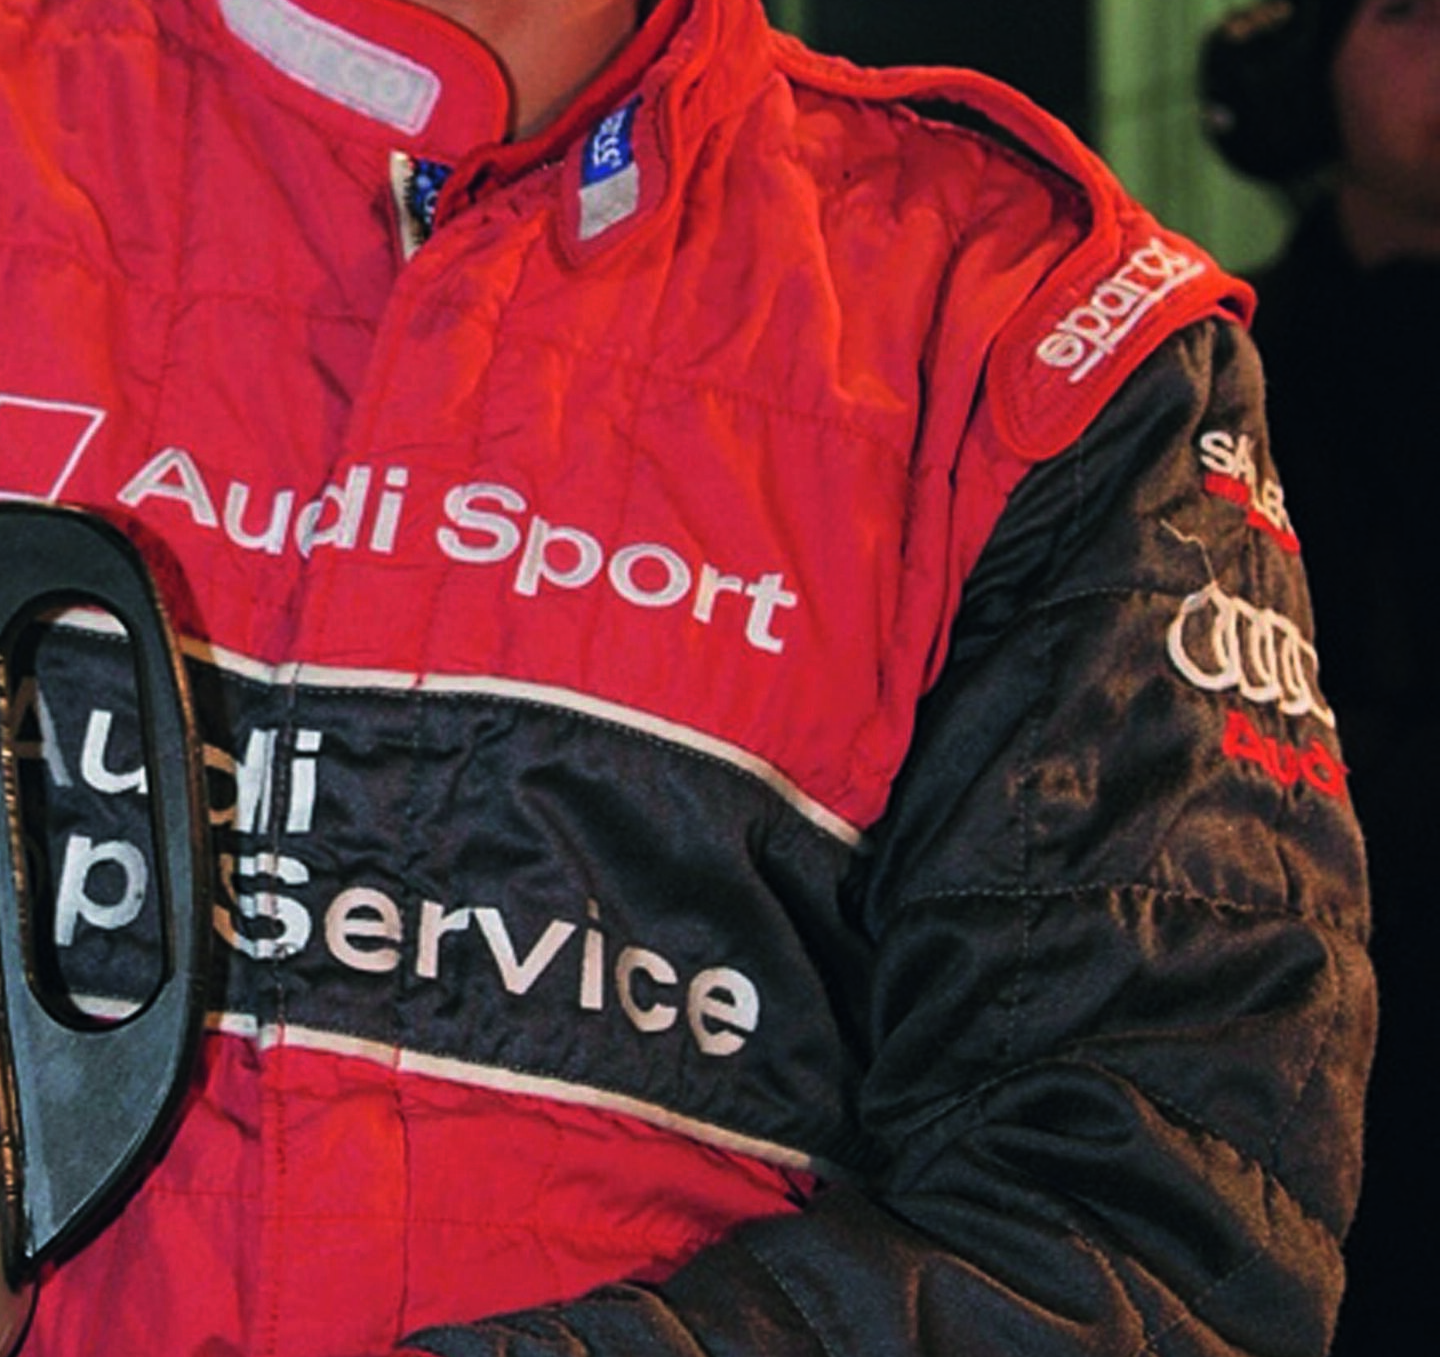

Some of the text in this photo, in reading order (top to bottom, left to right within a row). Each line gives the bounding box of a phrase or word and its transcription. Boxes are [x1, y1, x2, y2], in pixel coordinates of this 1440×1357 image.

[116, 446, 797, 654] Audi Sport
[212, 853, 759, 1058] Service
